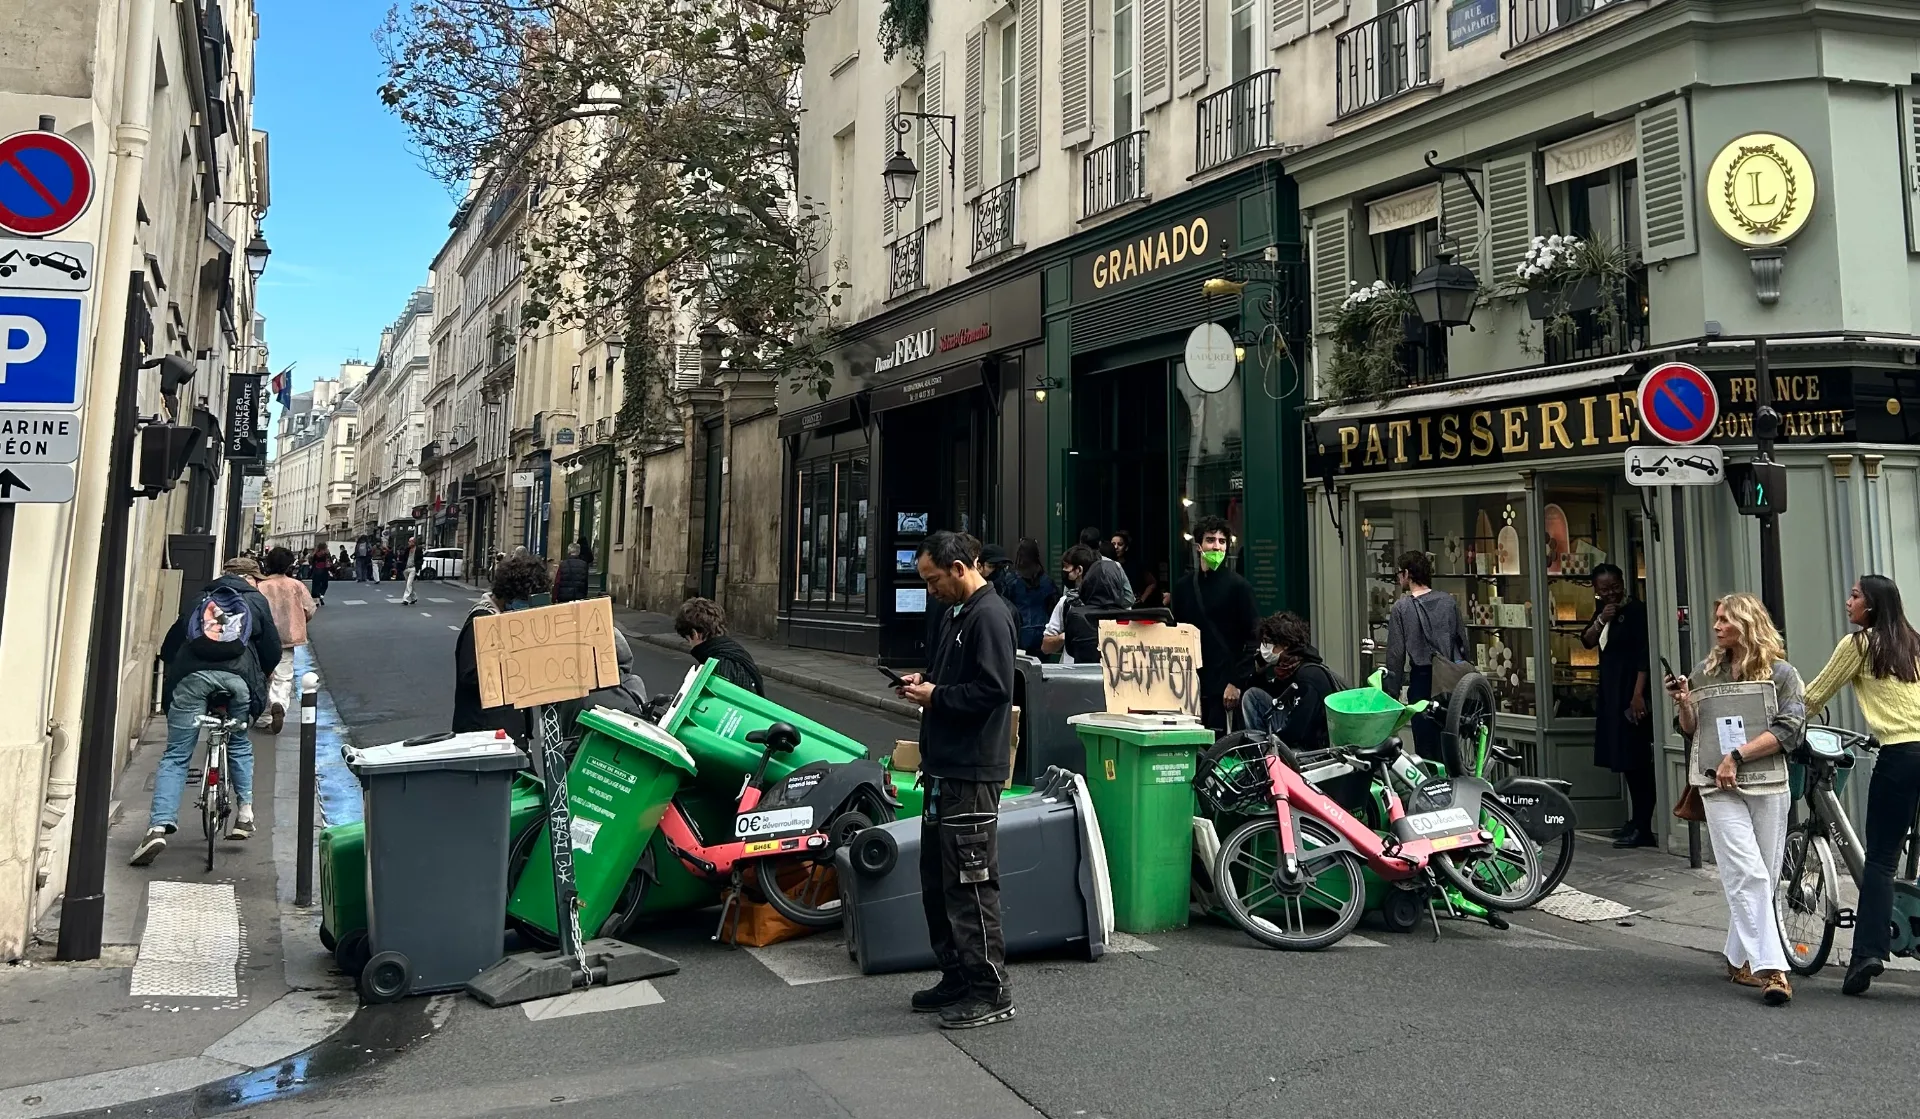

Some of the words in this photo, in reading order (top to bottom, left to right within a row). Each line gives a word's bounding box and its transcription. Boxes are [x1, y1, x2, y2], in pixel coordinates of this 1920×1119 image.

[1464, 5, 1482, 20] RUE
[1452, 13, 1496, 40] BONAPARTE
[1746, 171, 1778, 207] L
[1093, 217, 1209, 289] GRANADO
[0, 315, 47, 384] P
[1730, 375, 1820, 402] FRNCE
[242, 382, 253, 438] BONAPARTE
[0, 419, 69, 436] ARINE
[1338, 391, 1641, 468] PATISSERIE
[1712, 410, 1846, 438] BONARTE
[0, 437, 48, 455] ÉON
[508, 614, 583, 648] RUE
[505, 644, 617, 695] BLOQUÉ
[591, 759, 608, 770] MAIRIE
[788, 781, 806, 789] spend
[1512, 794, 1534, 805] Lime
[738, 815, 761, 833] 0€
[1412, 816, 1433, 831] €0
[1544, 813, 1565, 824] Lime
